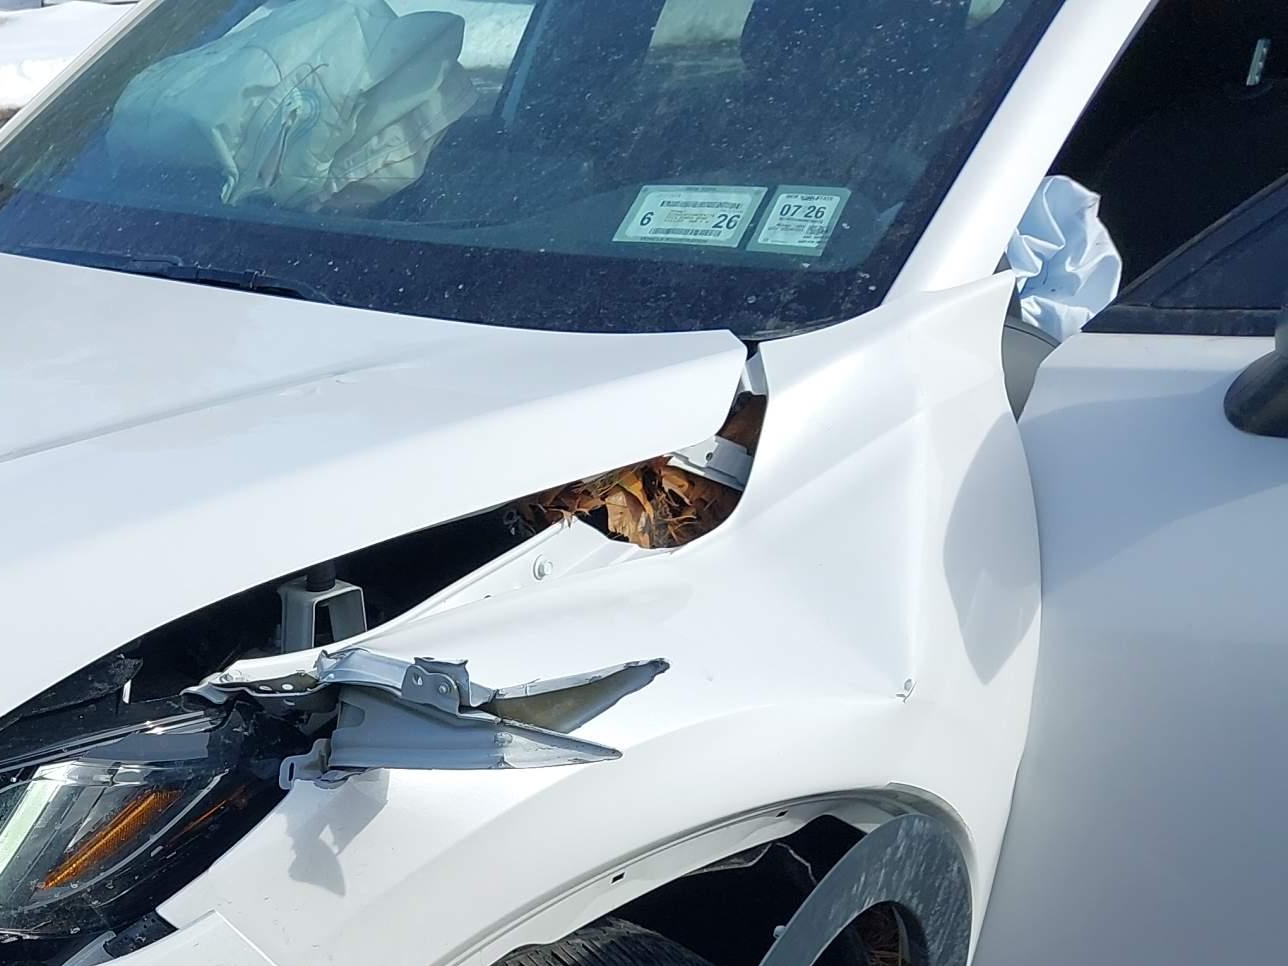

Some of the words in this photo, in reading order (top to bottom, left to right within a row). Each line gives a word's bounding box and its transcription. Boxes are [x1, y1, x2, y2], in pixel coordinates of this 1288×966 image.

[779, 203, 802, 217] 07
[803, 205, 827, 219] 26
[639, 211, 655, 227] 6
[711, 213, 741, 230] 26
